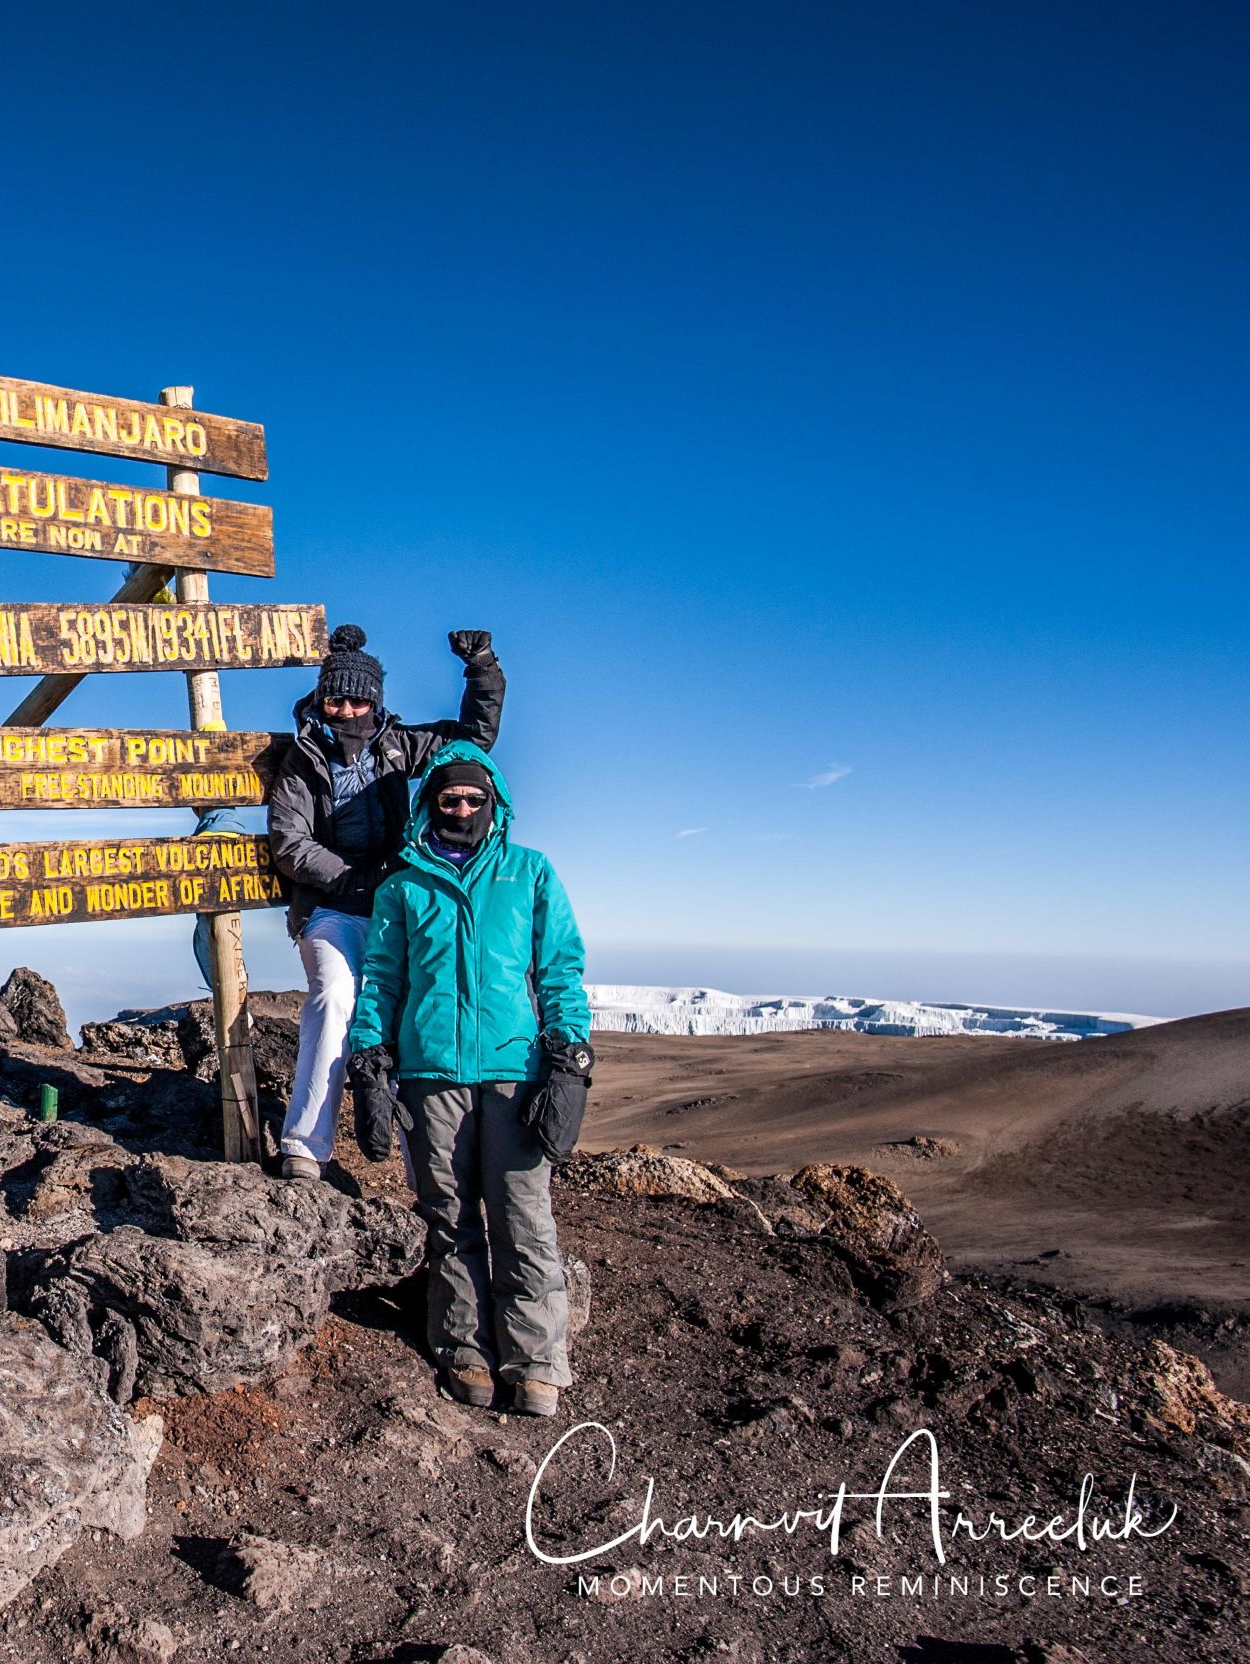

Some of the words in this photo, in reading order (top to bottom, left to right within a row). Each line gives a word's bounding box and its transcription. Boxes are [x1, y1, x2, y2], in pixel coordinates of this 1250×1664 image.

[49, 524, 102, 550] NOW
[113, 533, 142, 556] AT
[260, 611, 320, 660] AMSL
[127, 737, 211, 765] POINT
[180, 772, 263, 799] MOUNTAIN
[43, 846, 145, 879] LARGEST
[155, 842, 270, 872] VOLCANOES
[30, 885, 74, 917] AND
[86, 879, 169, 914] WONDER
[179, 878, 205, 906] OF
[218, 873, 283, 903] AFRICA
